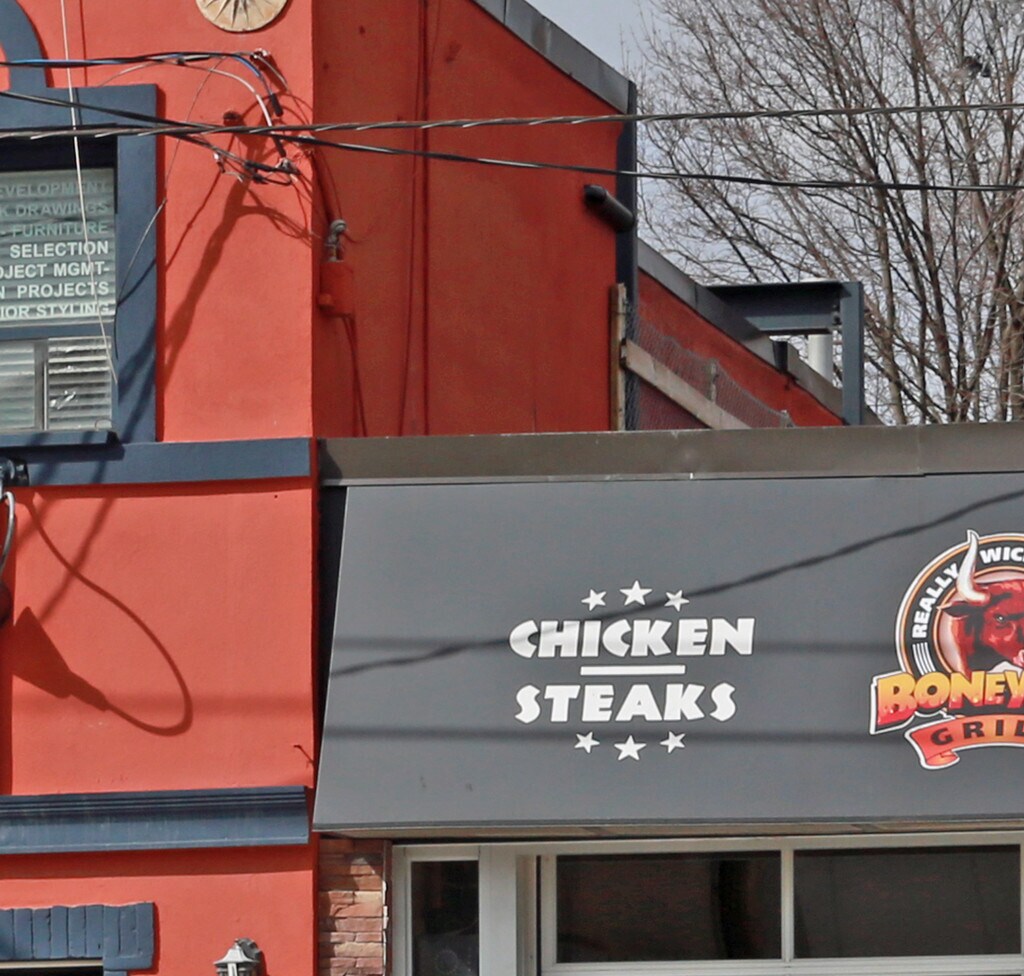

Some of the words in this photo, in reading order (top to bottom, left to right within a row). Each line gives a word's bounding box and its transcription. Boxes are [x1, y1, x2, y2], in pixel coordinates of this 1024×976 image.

[16, 202, 107, 217] DRAWINGS
[11, 221, 108, 237] FURNITURE
[10, 240, 109, 258] SELECTION
[17, 281, 109, 298] PROJECTS
[36, 303, 109, 317] STYLING
[911, 561, 960, 639] REALLY
[509, 617, 755, 658] CHICKEN
[514, 683, 737, 724] STEAKS
